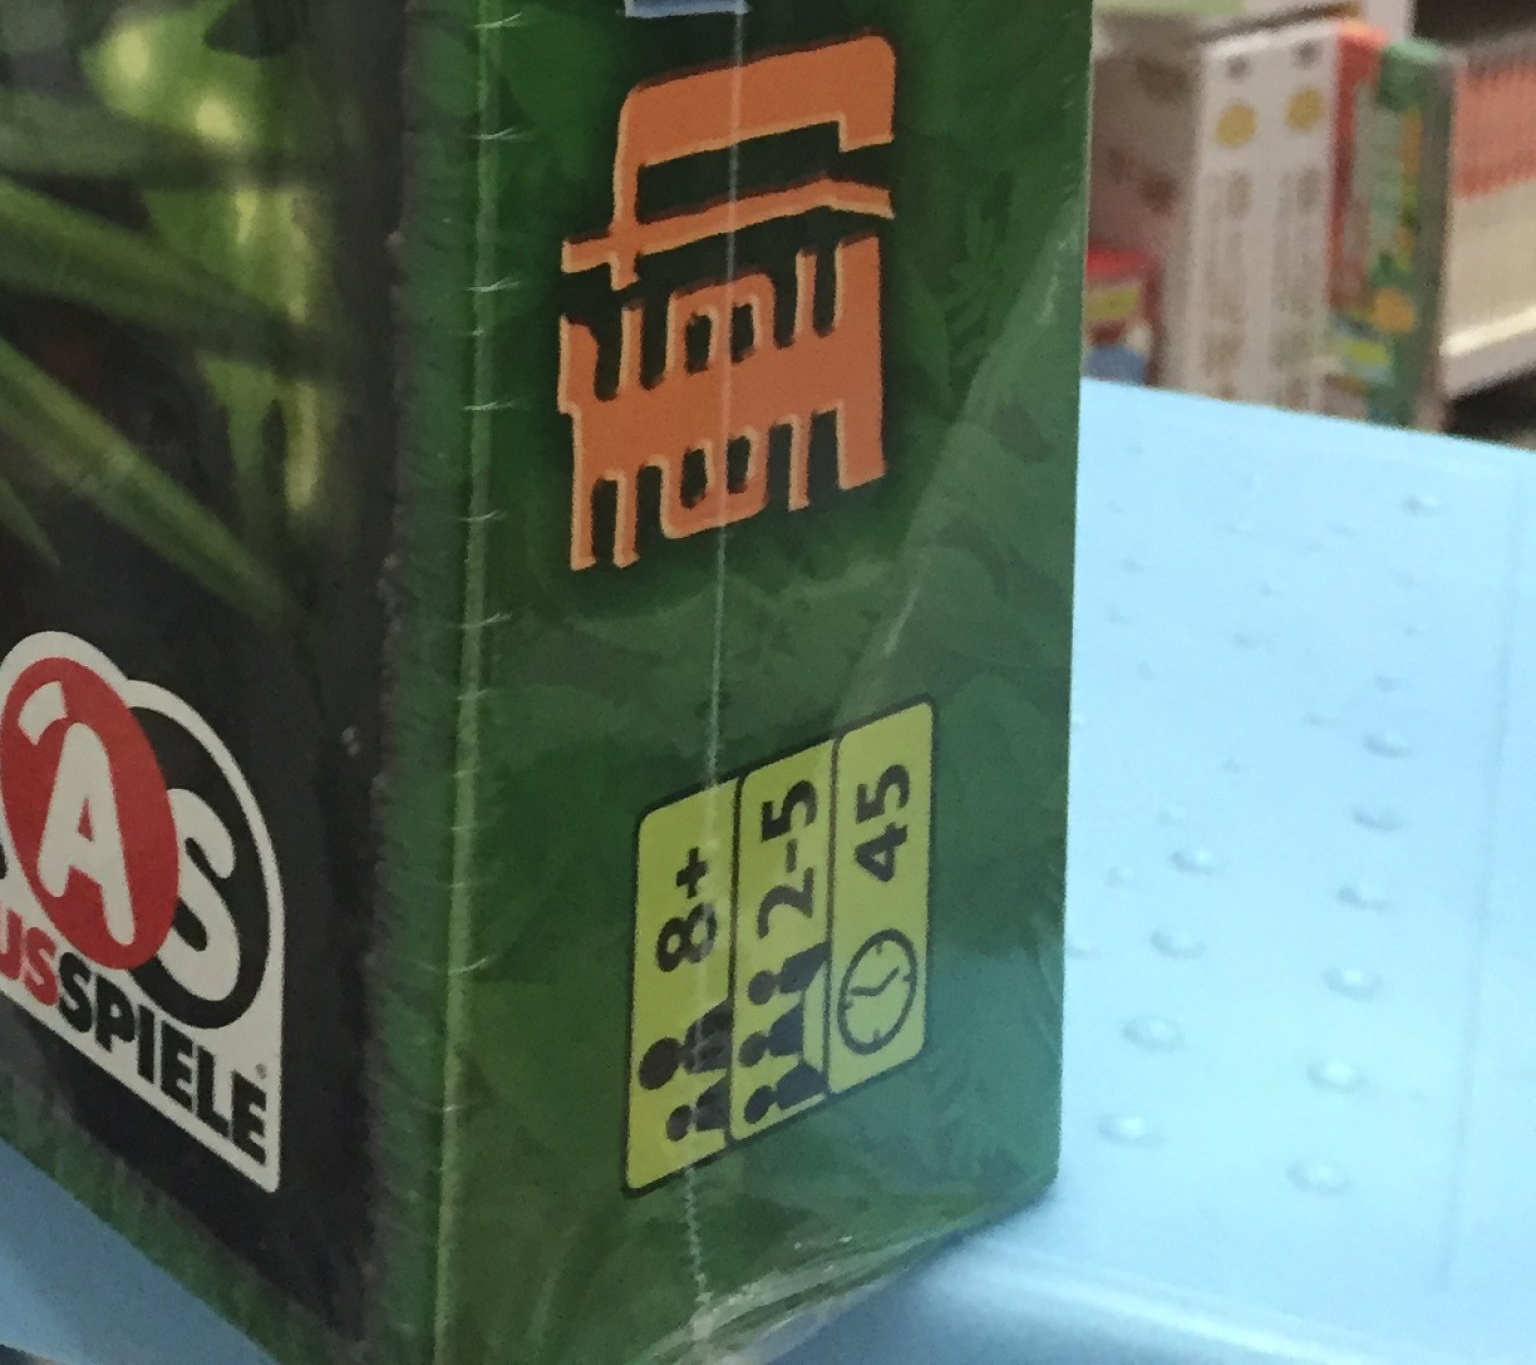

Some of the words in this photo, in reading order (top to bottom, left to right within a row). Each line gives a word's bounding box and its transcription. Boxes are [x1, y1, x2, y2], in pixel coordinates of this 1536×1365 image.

[756, 779, 819, 940] 2-5
[854, 763, 912, 884] 45
[655, 846, 719, 974] 8+
